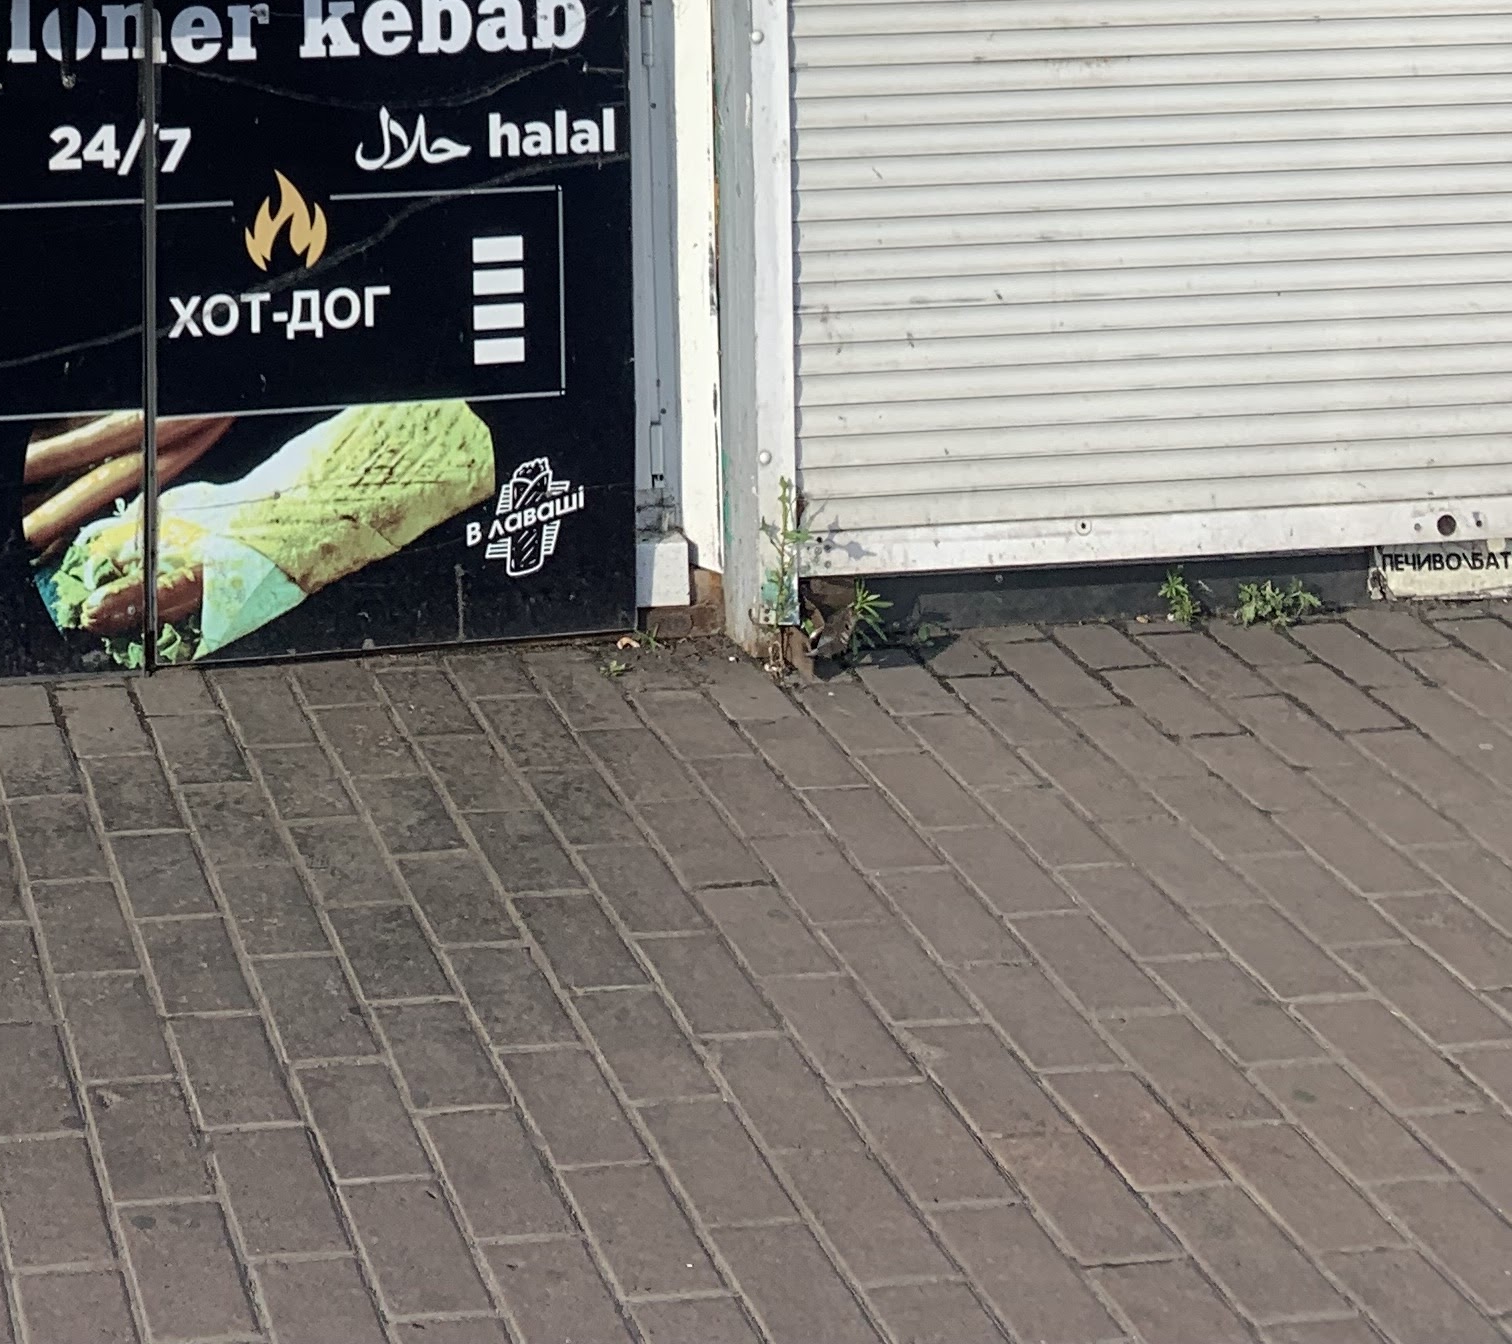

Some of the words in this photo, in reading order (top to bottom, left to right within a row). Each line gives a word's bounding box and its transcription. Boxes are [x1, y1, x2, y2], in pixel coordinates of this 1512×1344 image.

[49, 118, 191, 176] 24/7
[355, 105, 472, 170] حلال
[489, 108, 616, 158] halal
[168, 286, 390, 339] ХОТ-ДОГ
